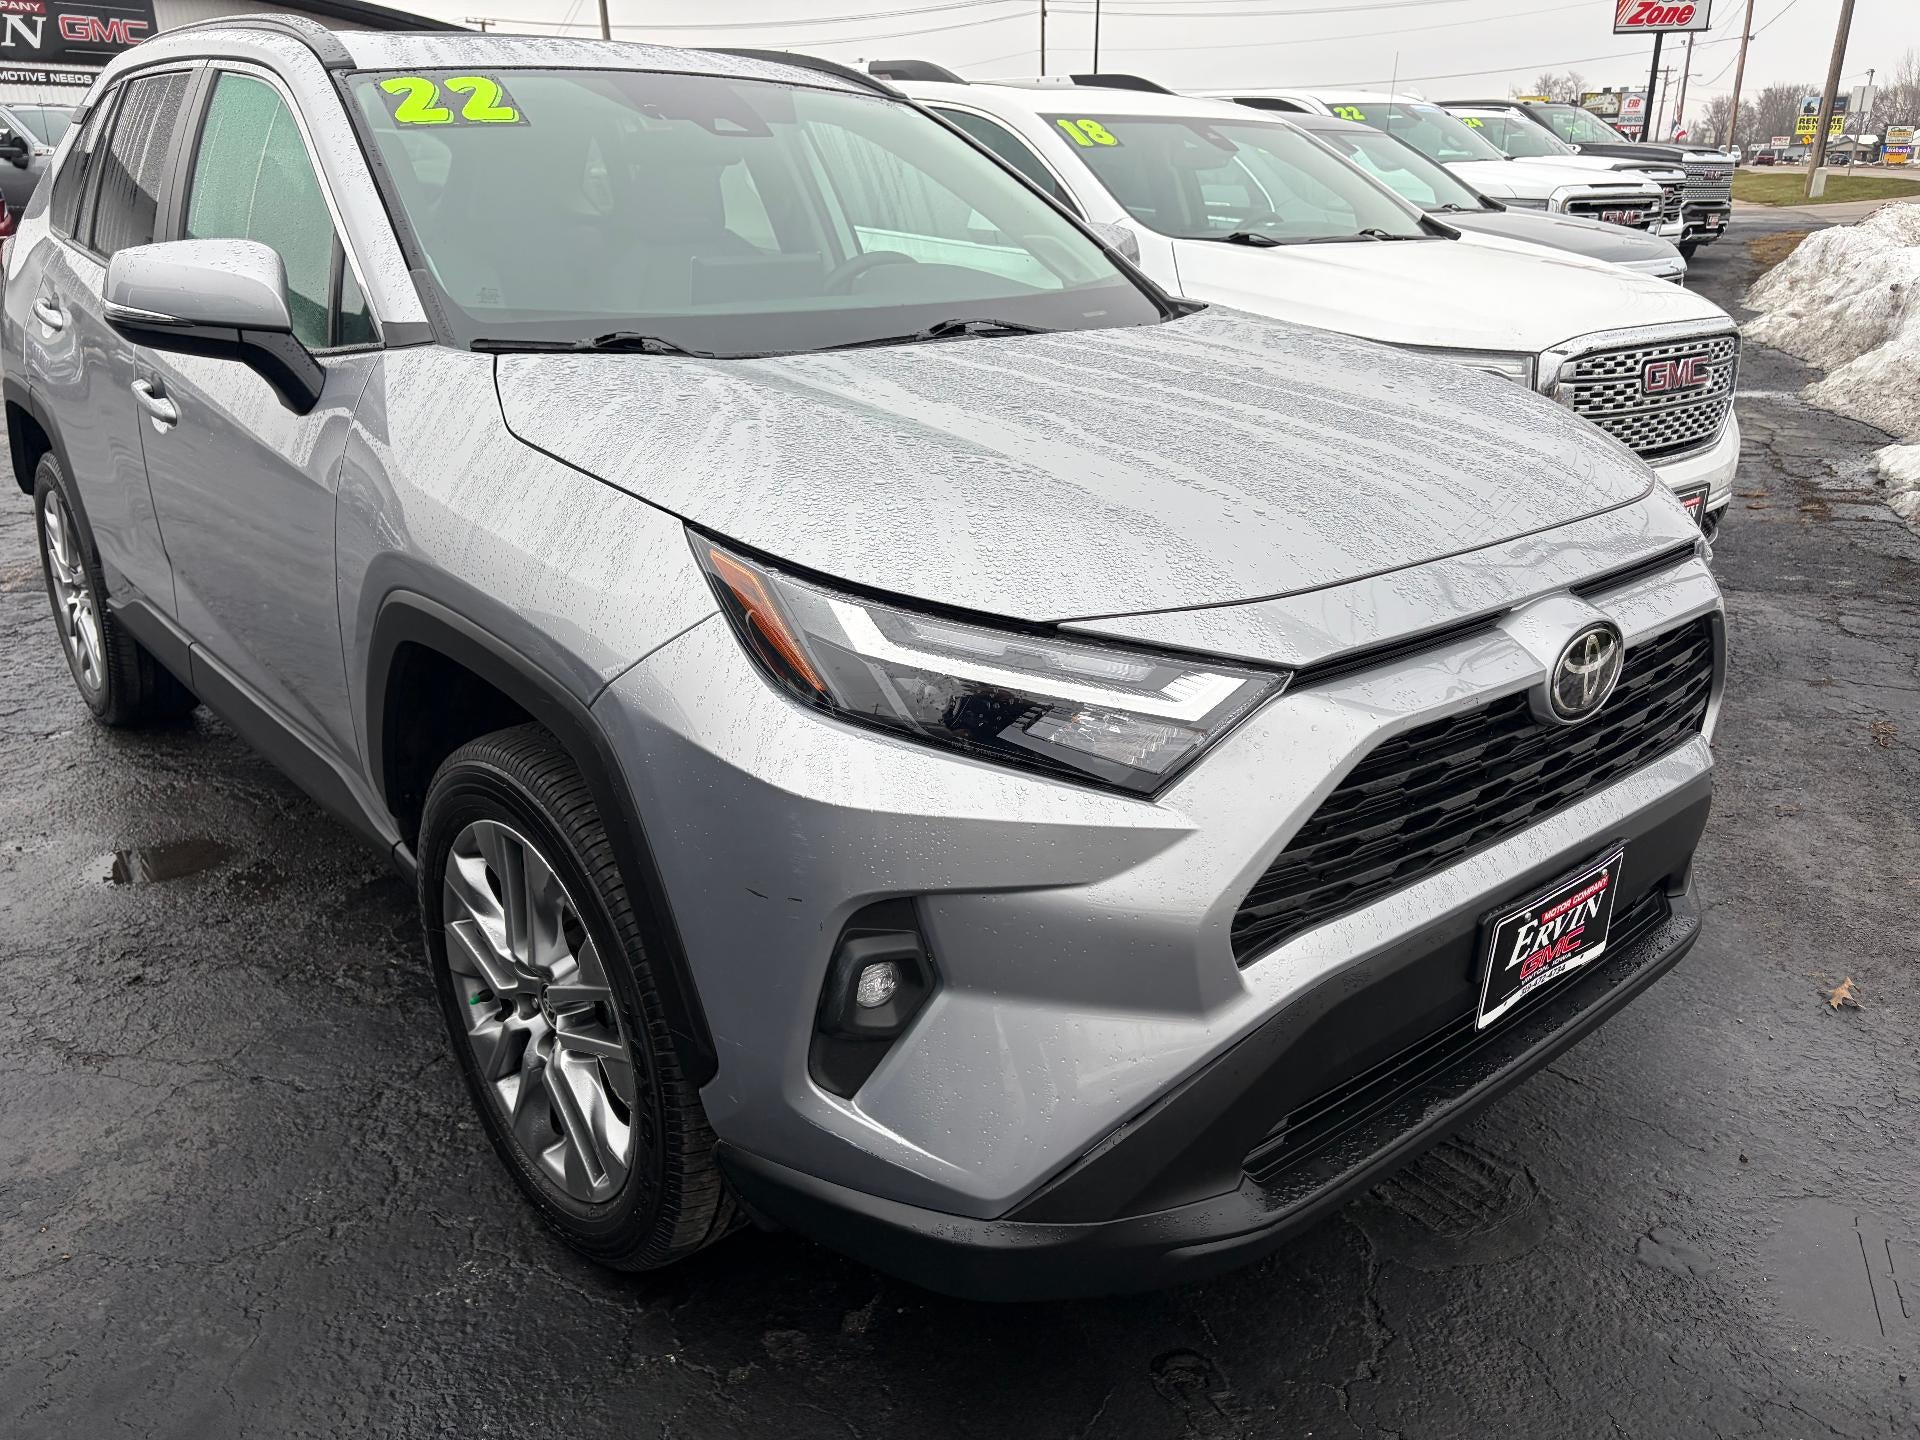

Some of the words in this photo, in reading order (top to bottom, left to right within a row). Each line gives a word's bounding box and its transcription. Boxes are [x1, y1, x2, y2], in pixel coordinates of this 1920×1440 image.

[58, 13, 149, 45] GMC
[1626, 2, 1696, 26] Zone
[49, 73, 93, 84] NEEDS
[380, 76, 519, 124] 22
[1333, 106, 1366, 121] 22
[1056, 119, 1117, 147] 18
[1602, 210, 1642, 225] GMC
[1646, 355, 1711, 391] GMC
[1544, 898, 1572, 921] MOTOR
[1572, 876, 1608, 905] COMPANY
[1505, 888, 1606, 971] ERVIN
[1519, 926, 1585, 979] GMC
